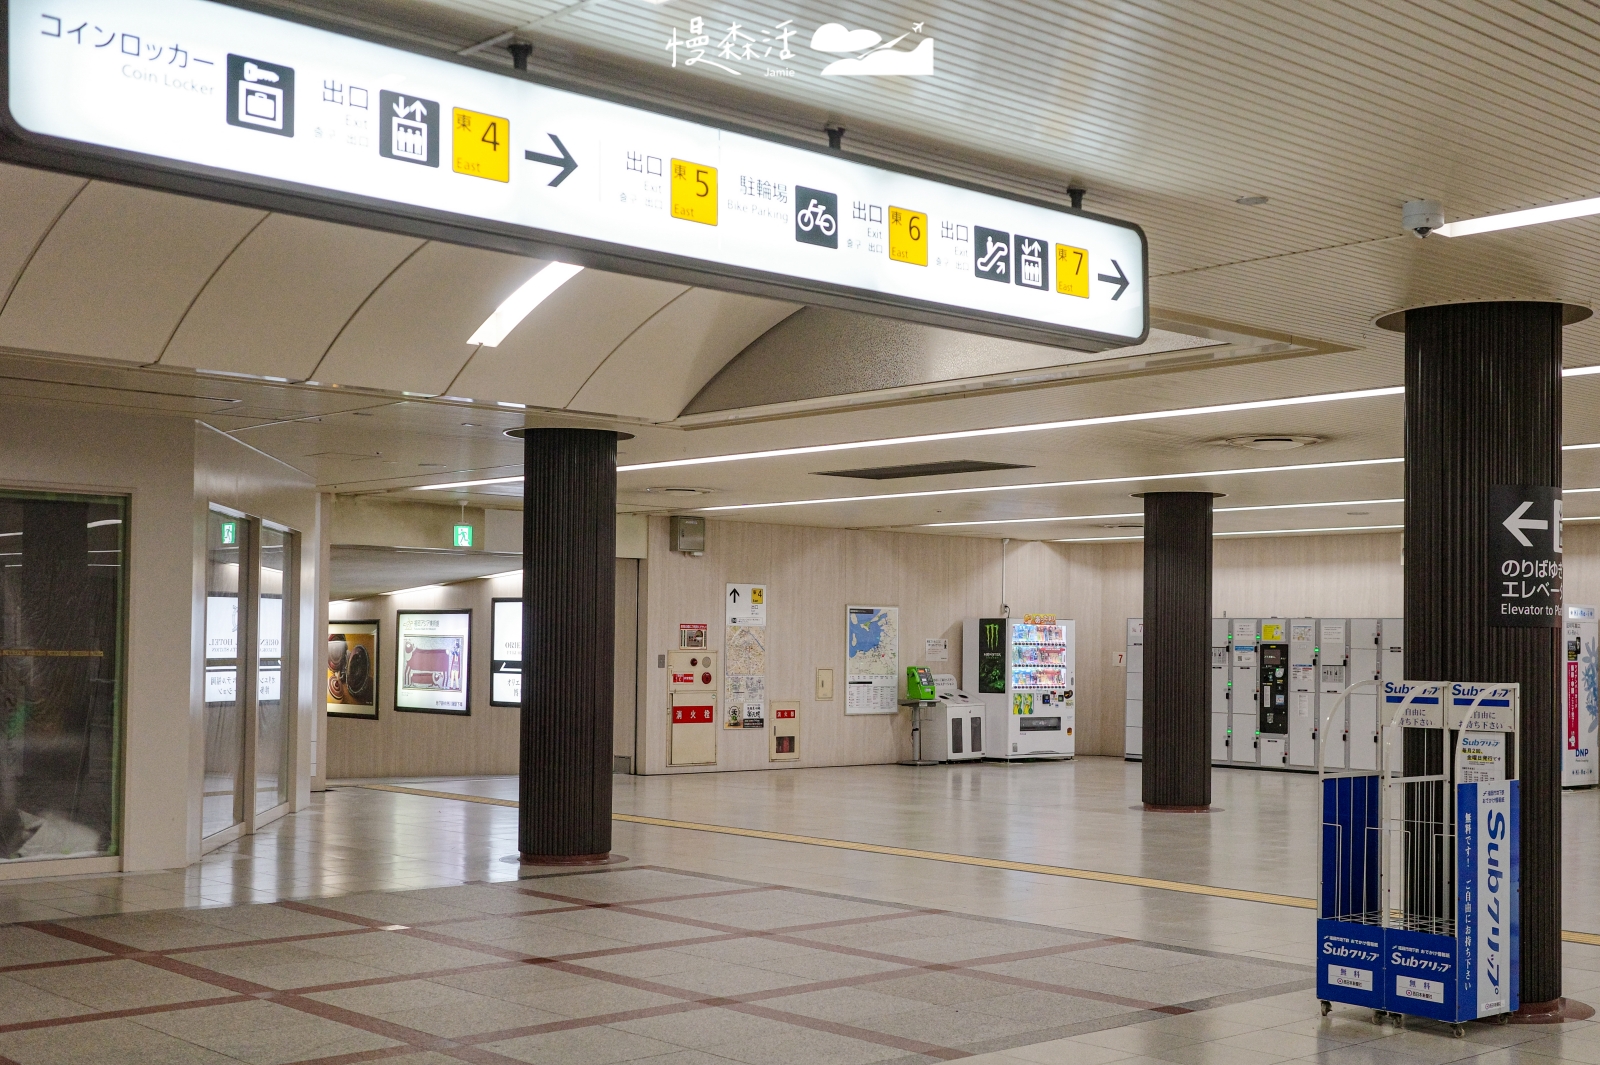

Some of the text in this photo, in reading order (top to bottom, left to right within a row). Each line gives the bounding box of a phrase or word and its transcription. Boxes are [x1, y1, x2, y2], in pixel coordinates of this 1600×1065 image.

[41, 13, 215, 69] コインロッカー
[121, 64, 215, 96] Coin Locker
[322, 79, 369, 110] 出口
[345, 114, 368, 130] Exit
[456, 113, 501, 152] 東 4
[456, 157, 481, 174] East
[626, 150, 662, 177] 出口
[644, 180, 662, 194] Exit
[674, 164, 710, 198] 東 5
[739, 174, 788, 204] 駐輪場
[674, 203, 695, 218] East
[727, 199, 789, 224] Bike Parking
[852, 200, 884, 225] 出口
[867, 227, 883, 240] Exit
[891, 210, 921, 242] 東 6
[940, 220, 969, 243] 出口
[868, 241, 883, 254] 出口
[891, 246, 909, 260] East
[954, 245, 969, 258] Exit
[1058, 247, 1084, 276] 東 7
[1058, 280, 1073, 293] East
[757, 590, 762, 598] 4
[1501, 603, 1543, 616] Elevator
[1546, 604, 1554, 616] to
[1118, 654, 1123, 664] 7
[676, 709, 710, 719] 消火栓
[1403, 708, 1426, 716] 自由に
[1470, 711, 1496, 719] 自由に
[1462, 738, 1500, 747] Subクリップ
[1576, 749, 1588, 757] DNP
[1487, 809, 1505, 995] Subクリップ
[1322, 941, 1380, 962] Subクリップ
[1390, 951, 1452, 973] Subクリップ
